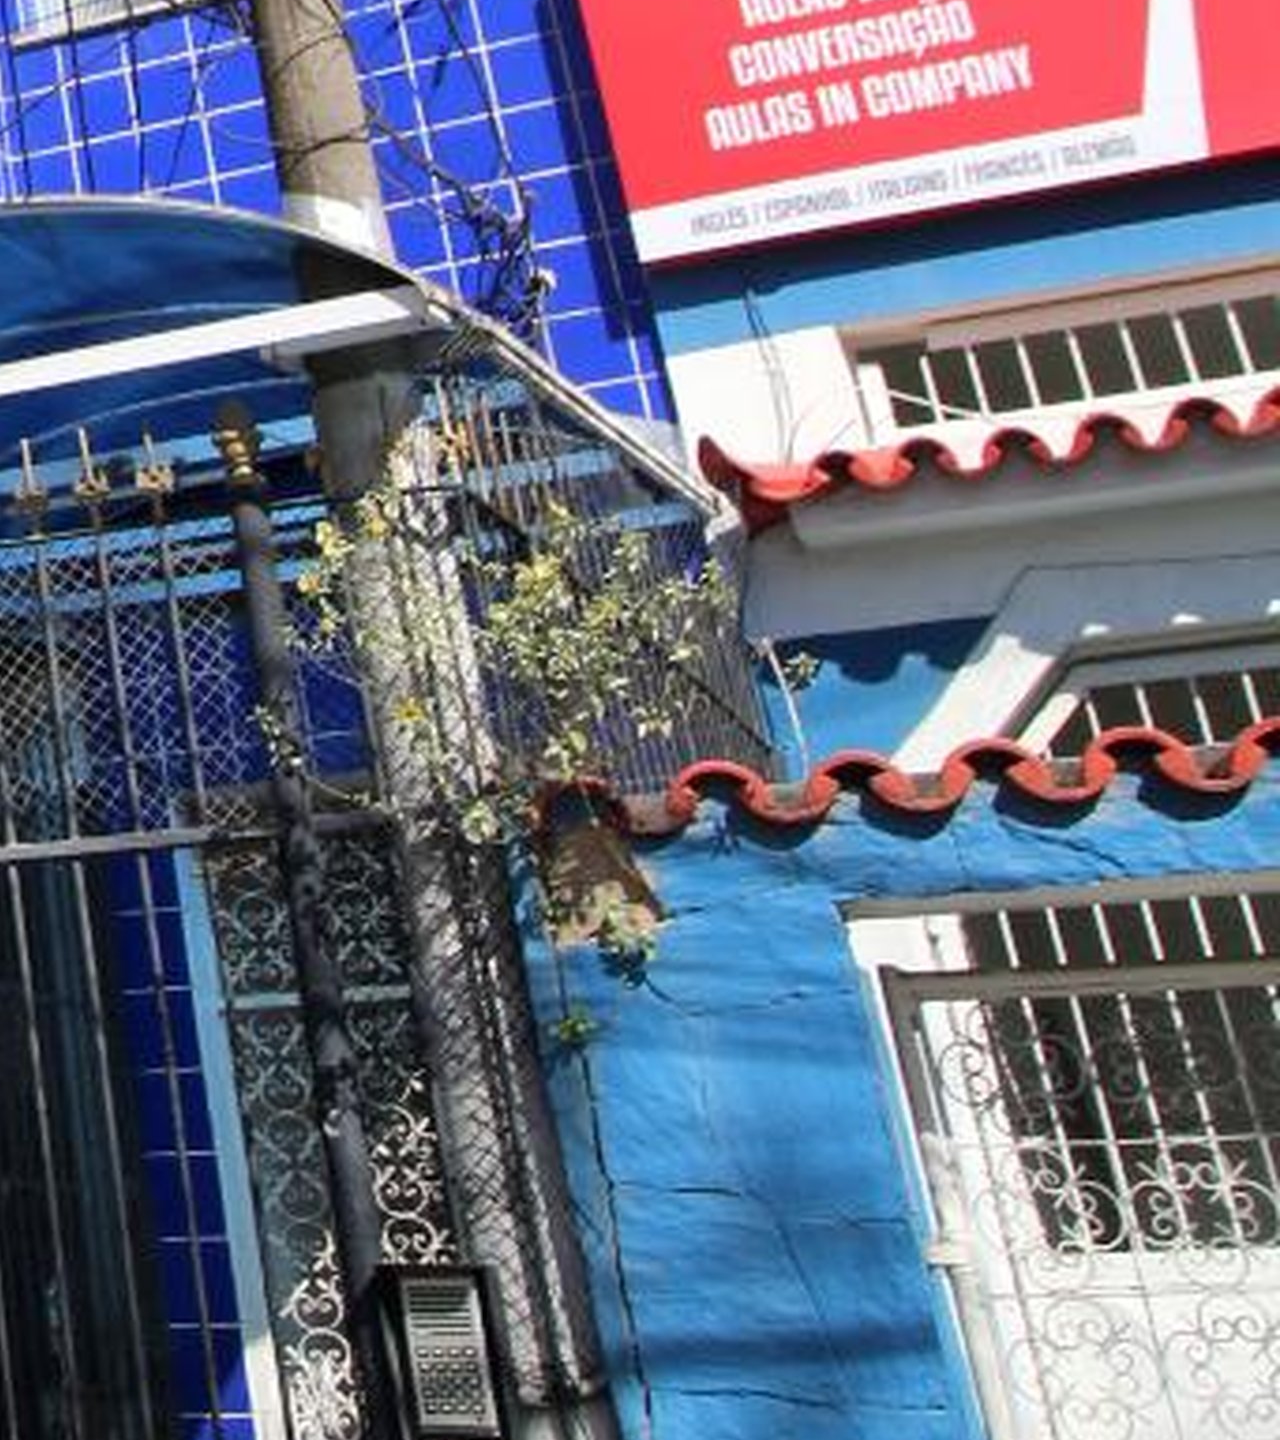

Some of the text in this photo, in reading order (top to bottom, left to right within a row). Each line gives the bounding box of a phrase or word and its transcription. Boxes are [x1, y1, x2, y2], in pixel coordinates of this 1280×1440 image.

[704, 45, 1033, 151] AULAS IN COMPANY
